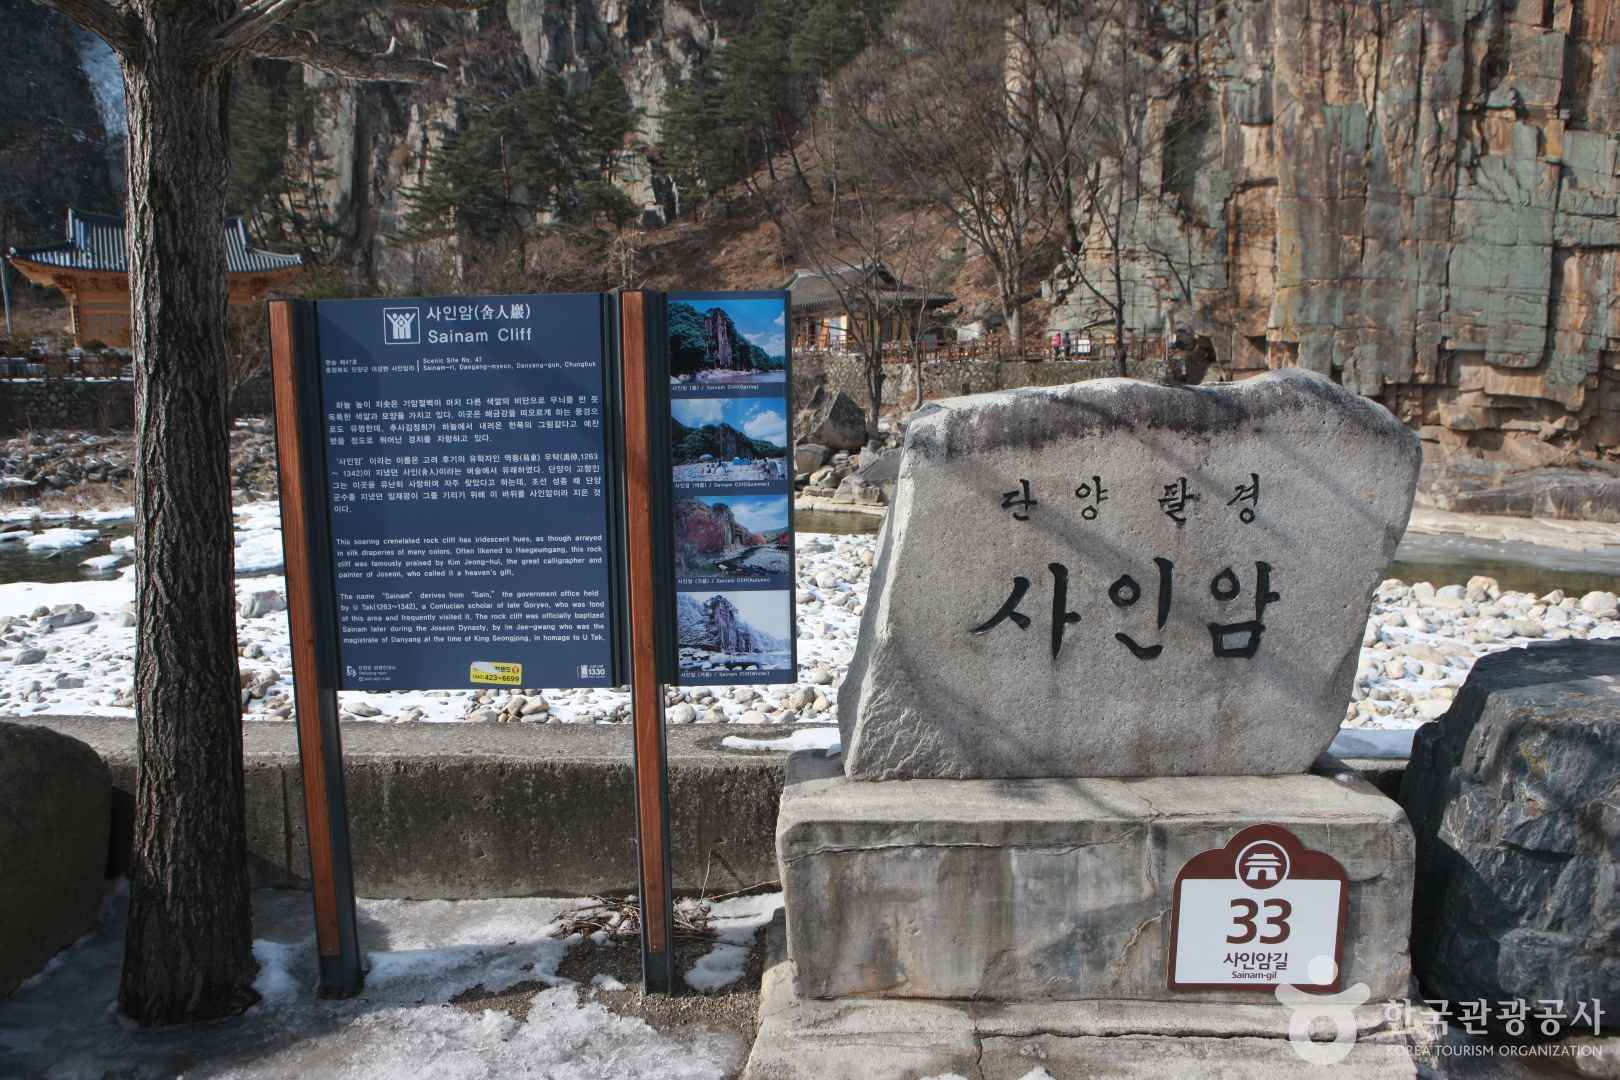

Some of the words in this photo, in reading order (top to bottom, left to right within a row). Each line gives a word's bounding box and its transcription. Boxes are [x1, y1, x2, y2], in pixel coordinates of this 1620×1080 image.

[428, 329, 488, 344] Sainam
[498, 327, 532, 342] Cliff
[1000, 472, 1261, 525] 단양팔경
[969, 556, 1281, 660] 사인암
[1226, 898, 1293, 944] 33
[1224, 952, 1288, 970] 사인암길
[1232, 970, 1278, 981] Sainam-gil
